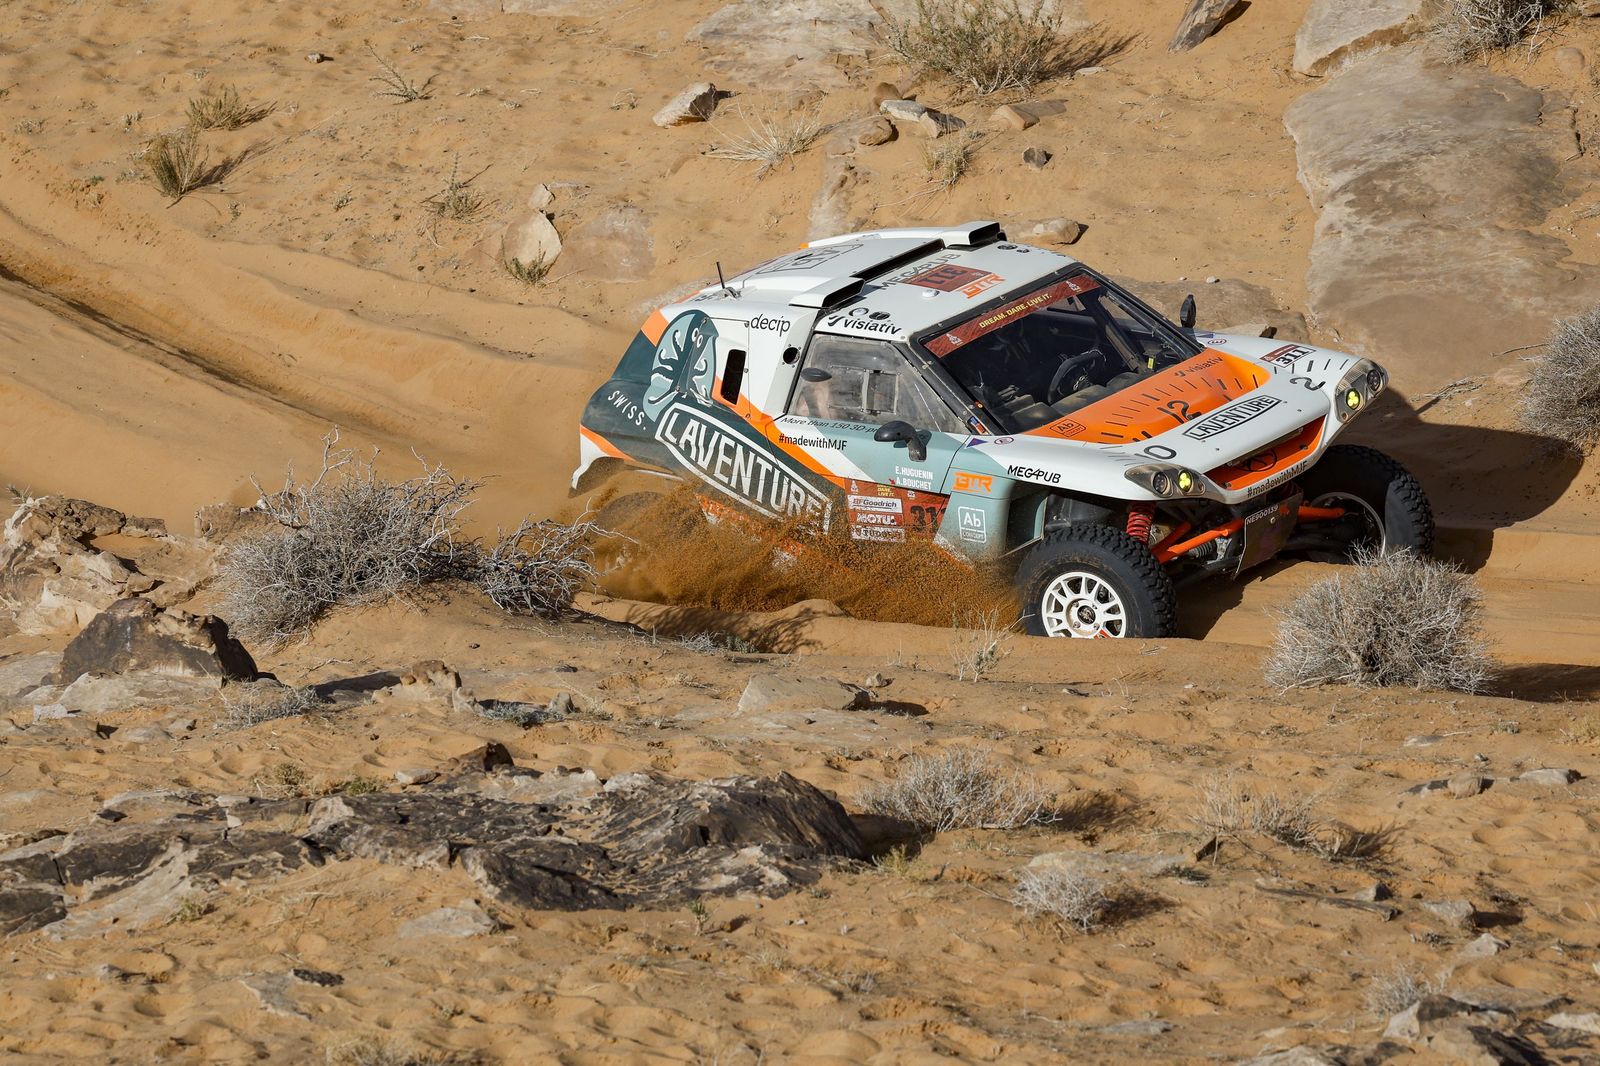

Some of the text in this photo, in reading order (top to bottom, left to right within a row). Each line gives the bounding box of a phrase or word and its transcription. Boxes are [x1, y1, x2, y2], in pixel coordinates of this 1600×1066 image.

[979, 292, 1052, 328] DREAM. DARE. LIVE IT.
[750, 313, 791, 337] decip
[843, 315, 902, 335] visiativ
[1276, 349, 1310, 365] 311
[608, 390, 647, 431] SWISS.
[1190, 396, 1275, 437] LAVENTURE
[781, 417, 806, 425] More
[807, 419, 829, 428] than
[829, 422, 848, 430] 150
[779, 433, 847, 451] #madewithMJF
[664, 411, 824, 522] LAVENTURE
[896, 466, 934, 480] E.HUGUENIN
[896, 477, 931, 490] A.BOUCHET
[1247, 461, 1308, 498] #madewithMJF
[857, 512, 897, 525] MOTUL
[963, 511, 981, 527] Ab
